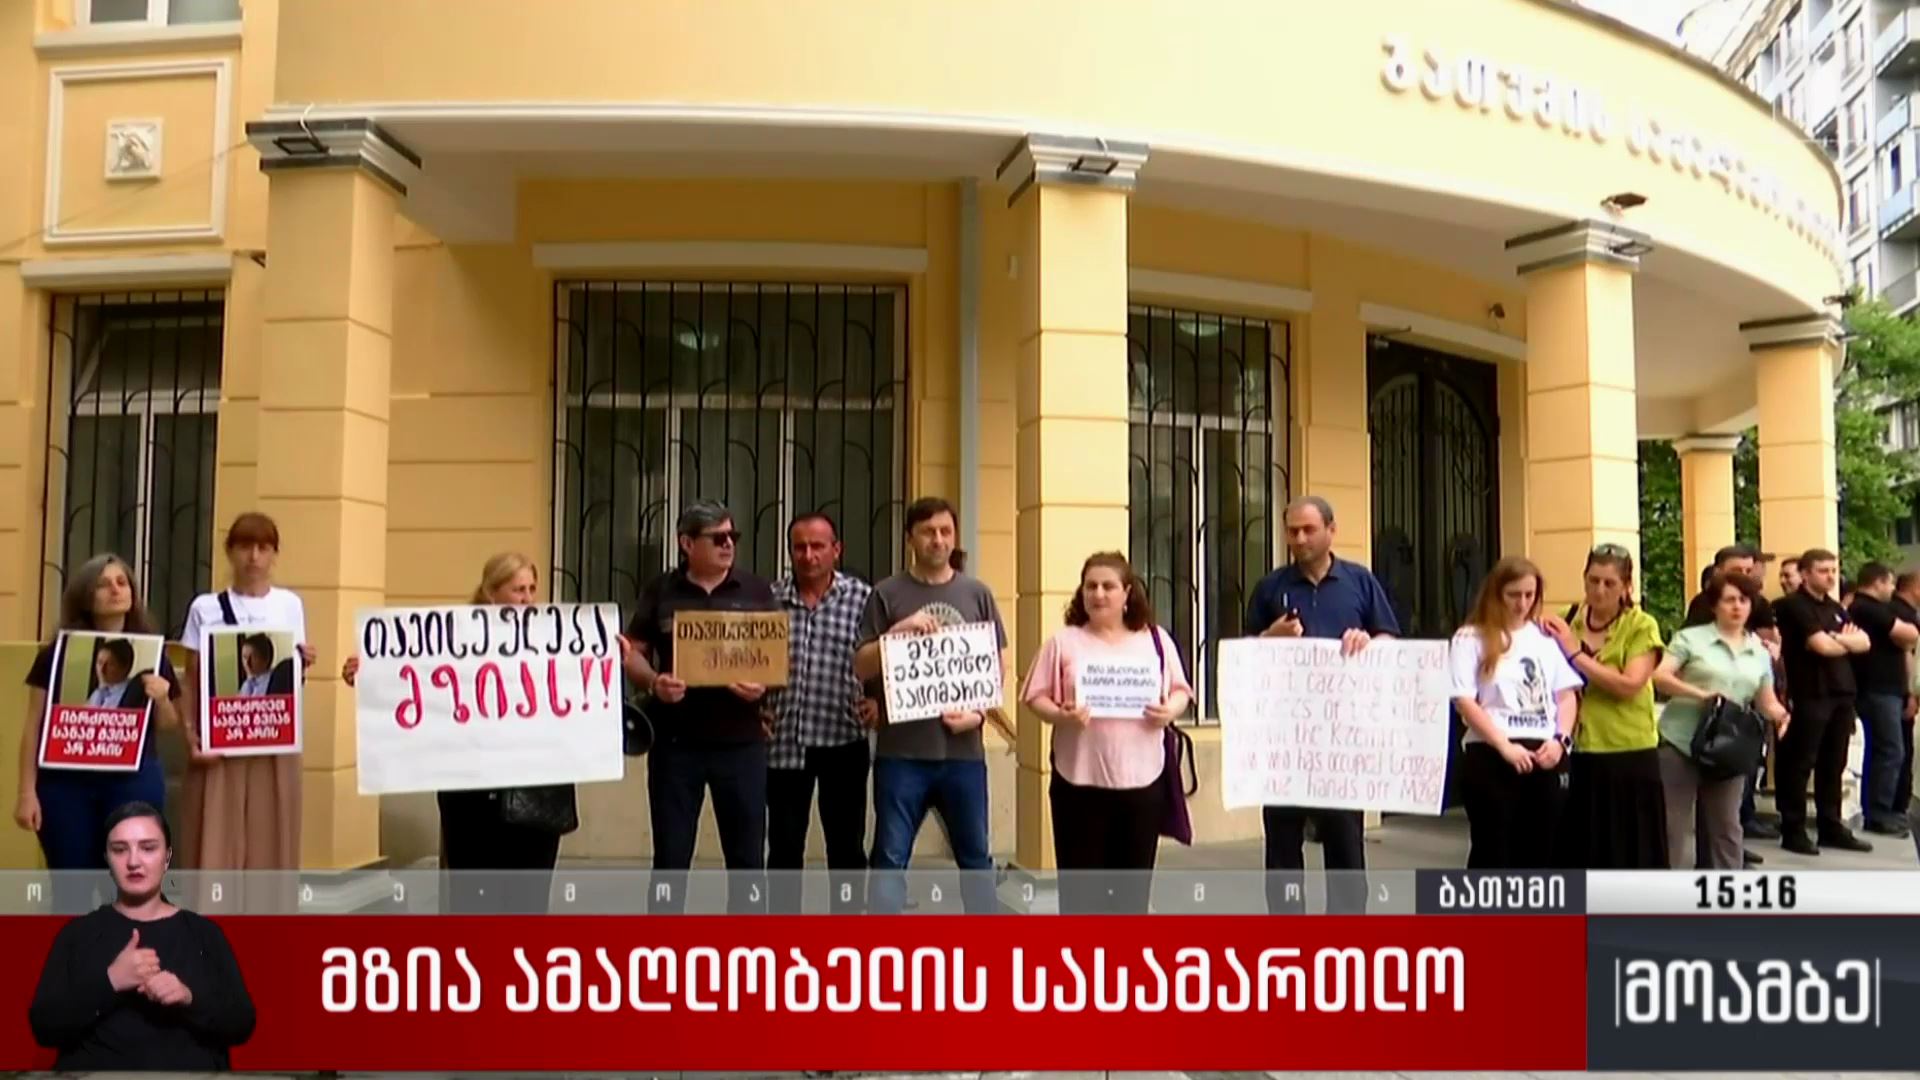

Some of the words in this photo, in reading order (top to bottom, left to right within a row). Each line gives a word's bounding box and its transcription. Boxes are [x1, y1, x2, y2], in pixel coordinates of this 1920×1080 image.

[364, 604, 608, 659] თავისუფლება
[677, 620, 787, 641] თავისუფლება
[907, 636, 971, 660] მზია
[894, 654, 992, 682] უკანონო
[395, 657, 614, 729] მზიას!!
[63, 740, 84, 755] არ
[87, 741, 125, 757] არის
[1297, 747, 1322, 772] has
[1306, 772, 1358, 800] hands
